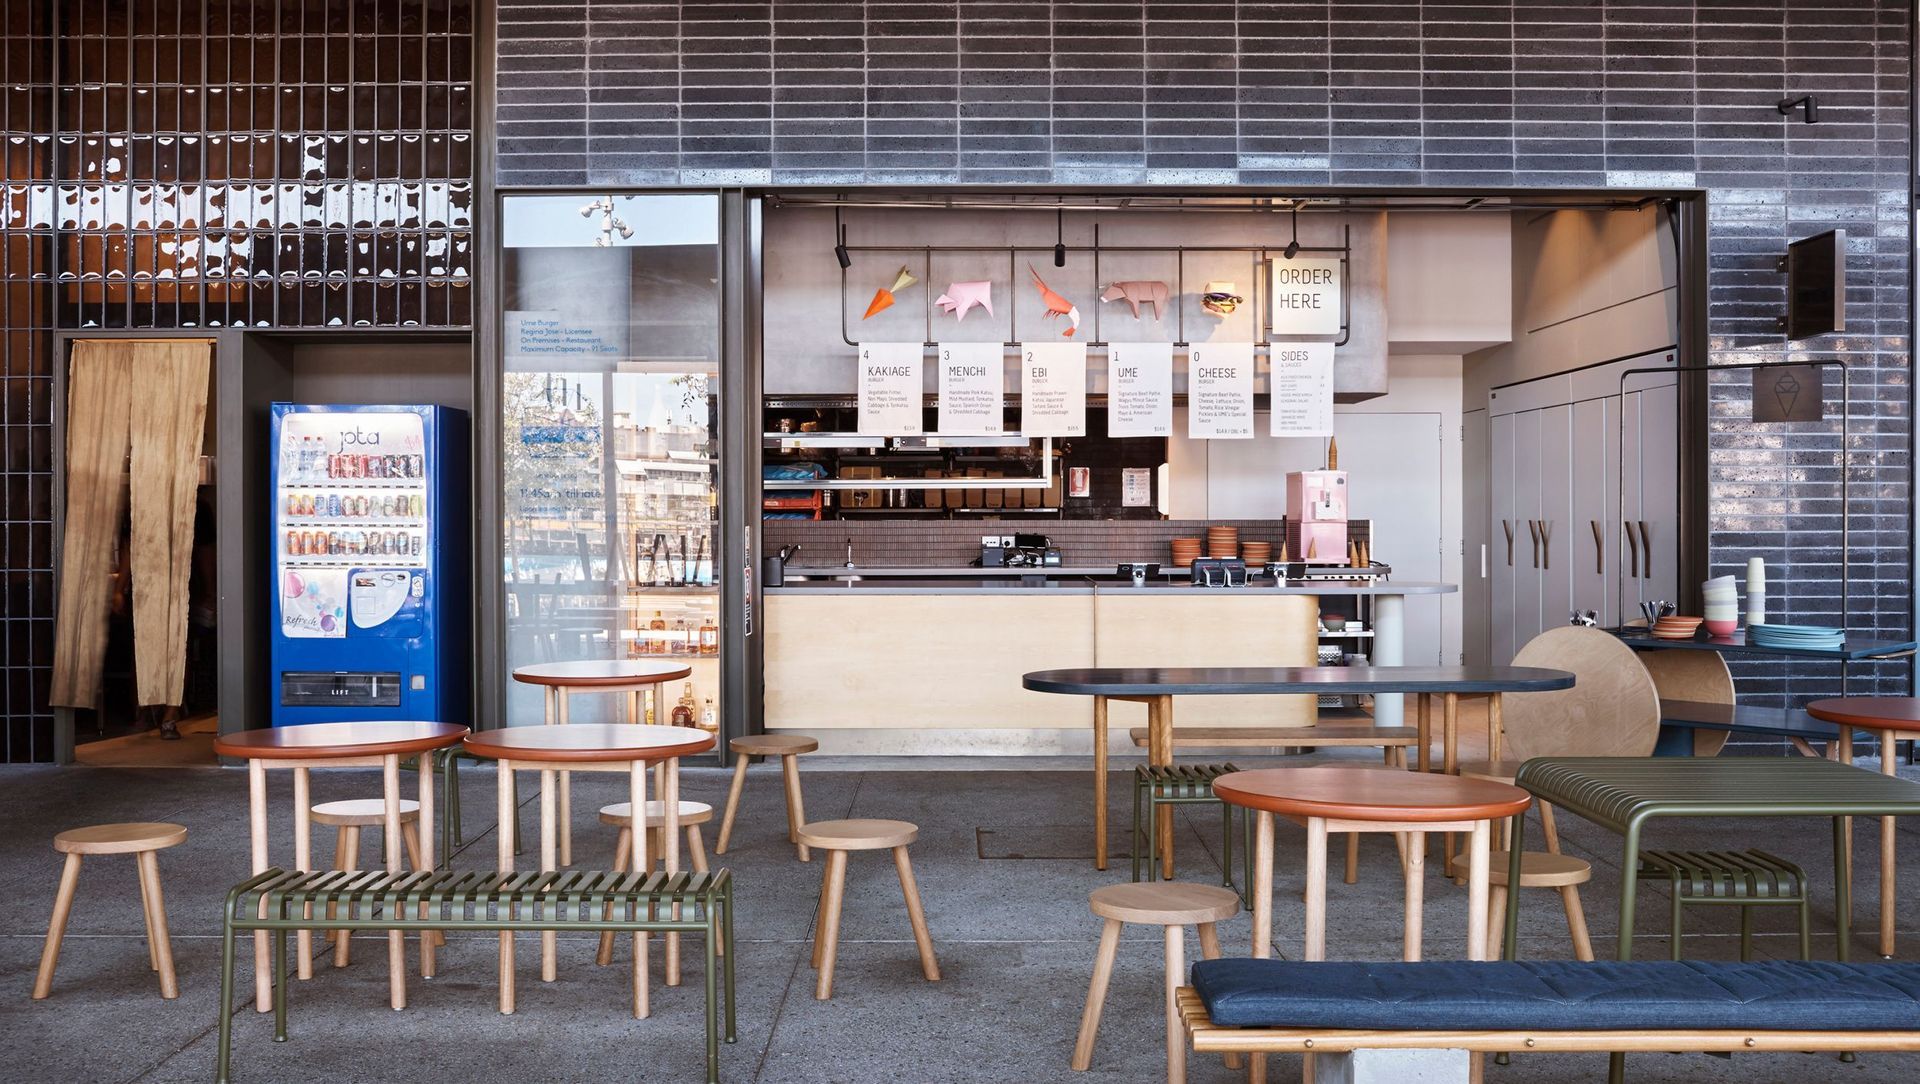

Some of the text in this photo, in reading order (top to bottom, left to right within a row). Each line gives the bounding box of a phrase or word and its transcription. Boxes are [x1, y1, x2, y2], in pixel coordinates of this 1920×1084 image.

[1280, 269, 1332, 284] ORDER
[1280, 294, 1321, 309] HERE
[520, 328, 543, 336] Regina
[863, 351, 869, 359] 4
[944, 351, 950, 360] 3
[1028, 352, 1033, 361] 2
[1114, 352, 1119, 361] 1
[1194, 352, 1199, 361] 0
[1281, 351, 1308, 361] SIDES
[868, 366, 911, 377] KAKIAGE
[949, 367, 986, 377] MENCHI
[1032, 368, 1047, 377] EBI
[1118, 367, 1138, 377] UME
[1199, 368, 1236, 378] CHEESE
